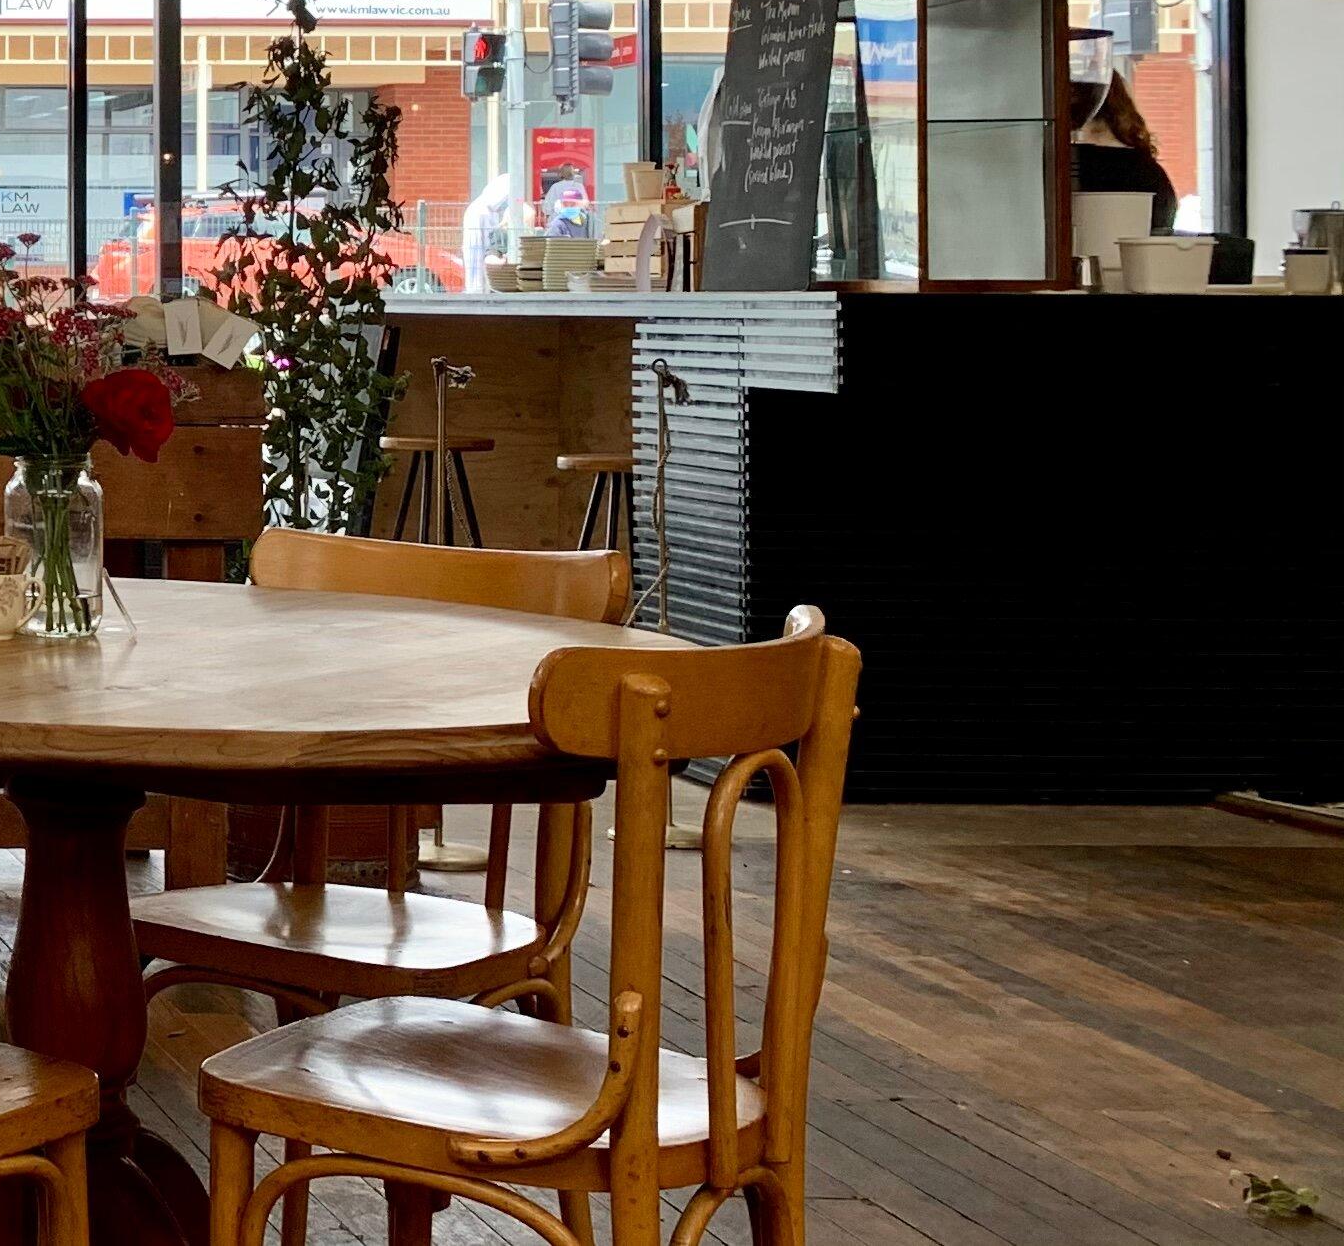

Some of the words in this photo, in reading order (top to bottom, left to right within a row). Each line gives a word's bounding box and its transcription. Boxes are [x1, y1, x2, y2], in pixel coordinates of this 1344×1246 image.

[315, 4, 451, 16] www.kmlawvic.com.au
[1, 191, 29, 202] KM
[1, 203, 40, 214] LAW
